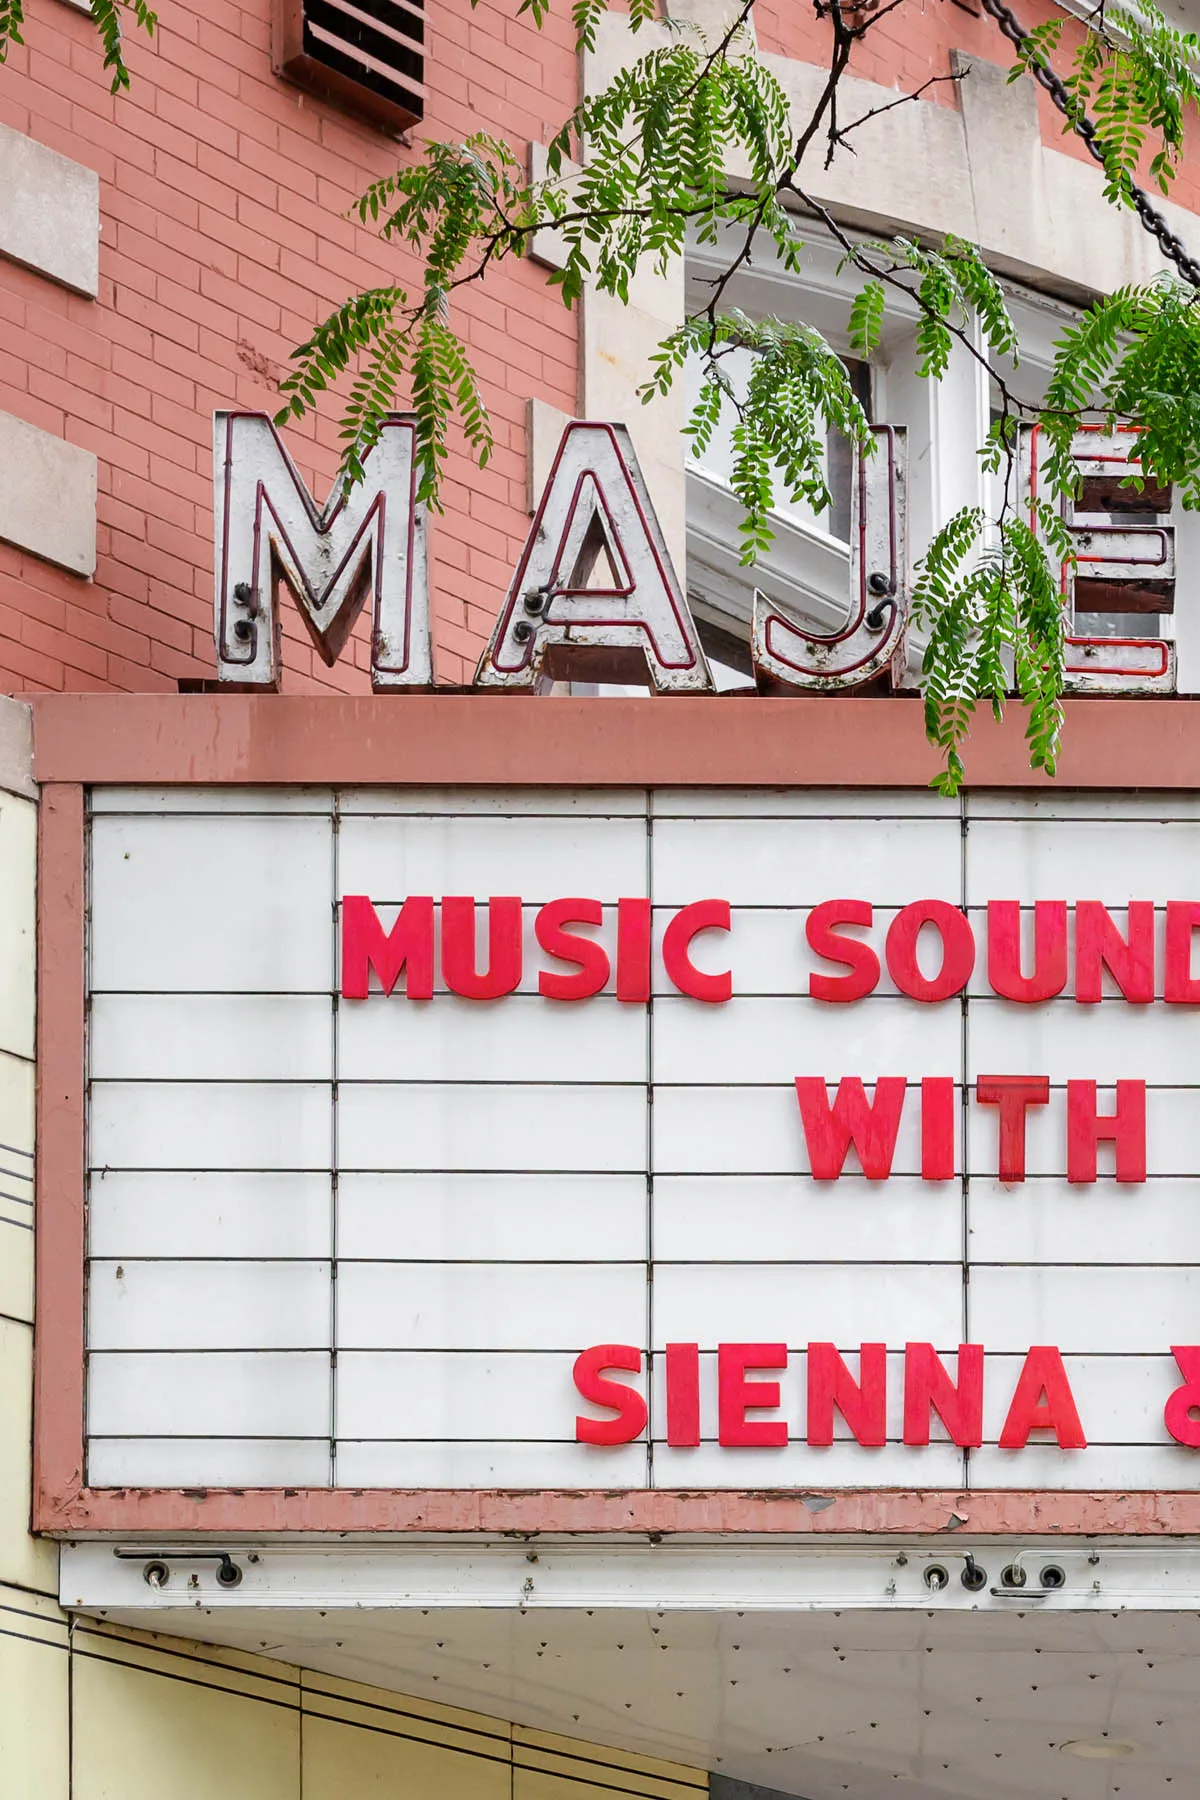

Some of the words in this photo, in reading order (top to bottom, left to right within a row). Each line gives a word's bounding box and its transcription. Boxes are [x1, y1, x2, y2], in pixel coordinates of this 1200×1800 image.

[341, 895, 732, 1003] MUSIC
[795, 1074, 1147, 1184] WITH
[572, 1342, 1086, 1450] SIENNA
